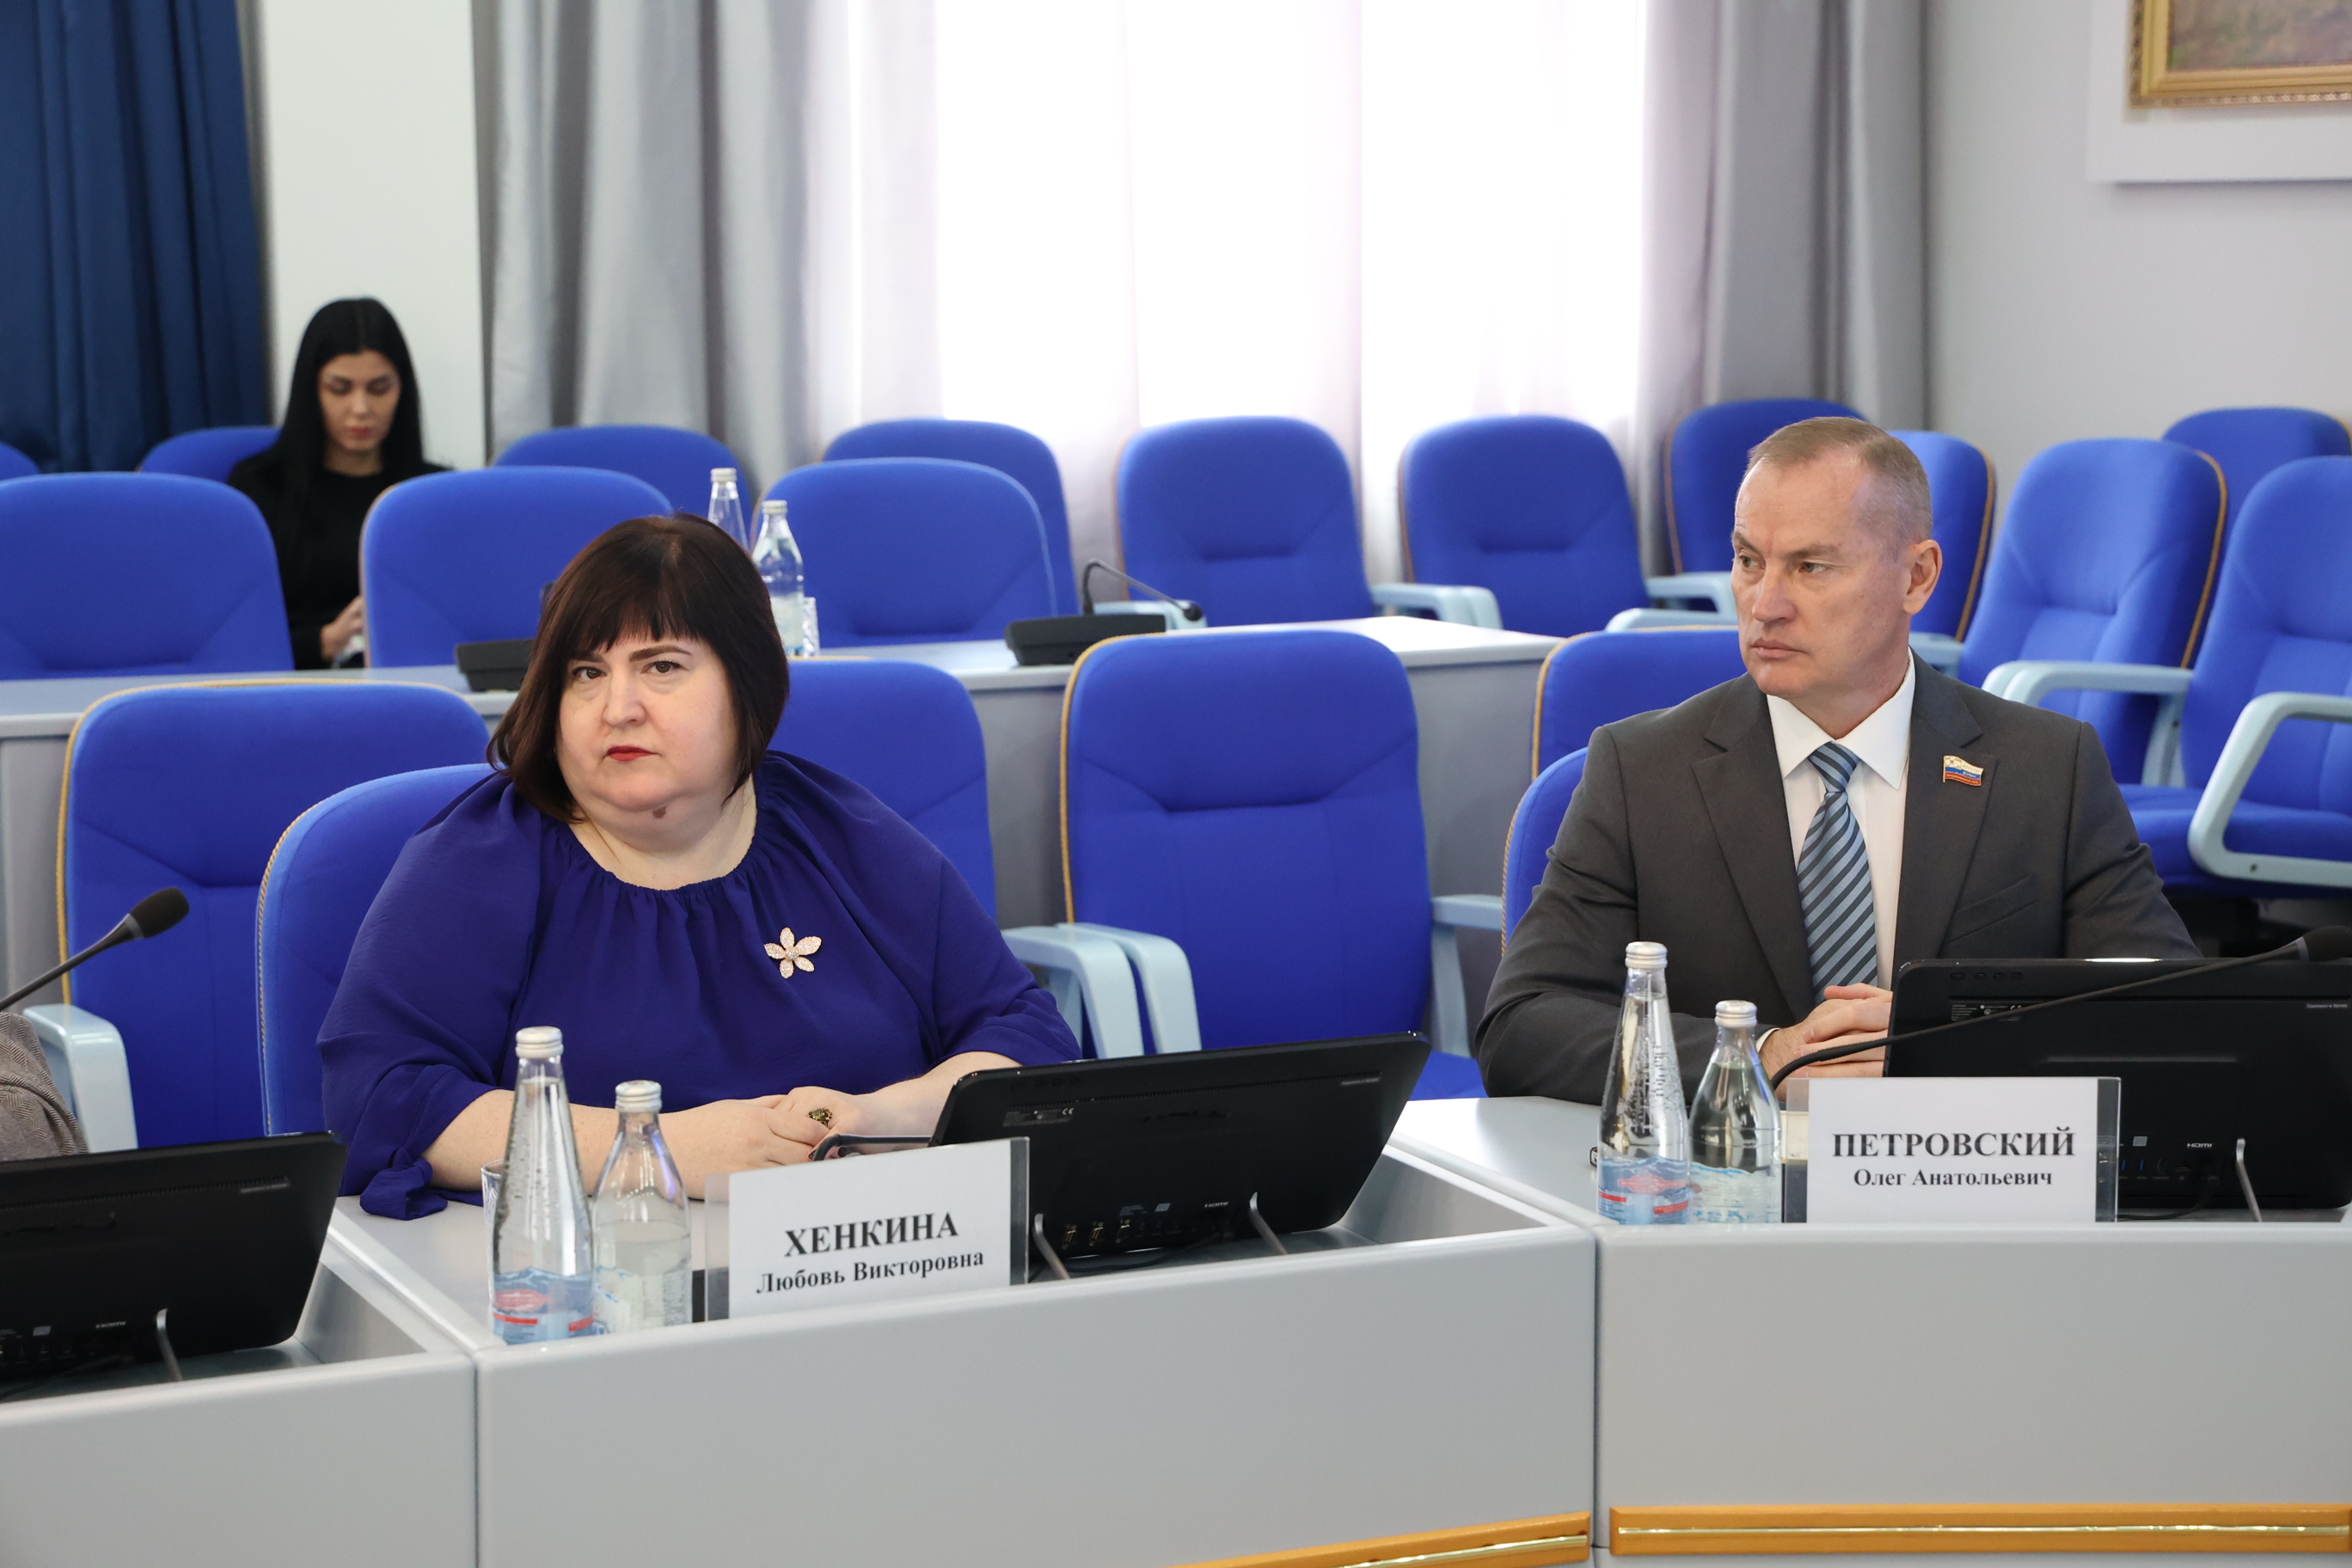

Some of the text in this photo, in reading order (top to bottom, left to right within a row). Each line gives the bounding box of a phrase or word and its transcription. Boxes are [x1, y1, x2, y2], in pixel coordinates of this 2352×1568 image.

[1833, 1126, 2075, 1157] ПЕТРОВСКИЙ
[1853, 1169, 2052, 1186] Олег Анатольевич
[785, 1212, 959, 1257] ХЕНКИНА
[756, 1252, 983, 1294] Любовь Викторовна
